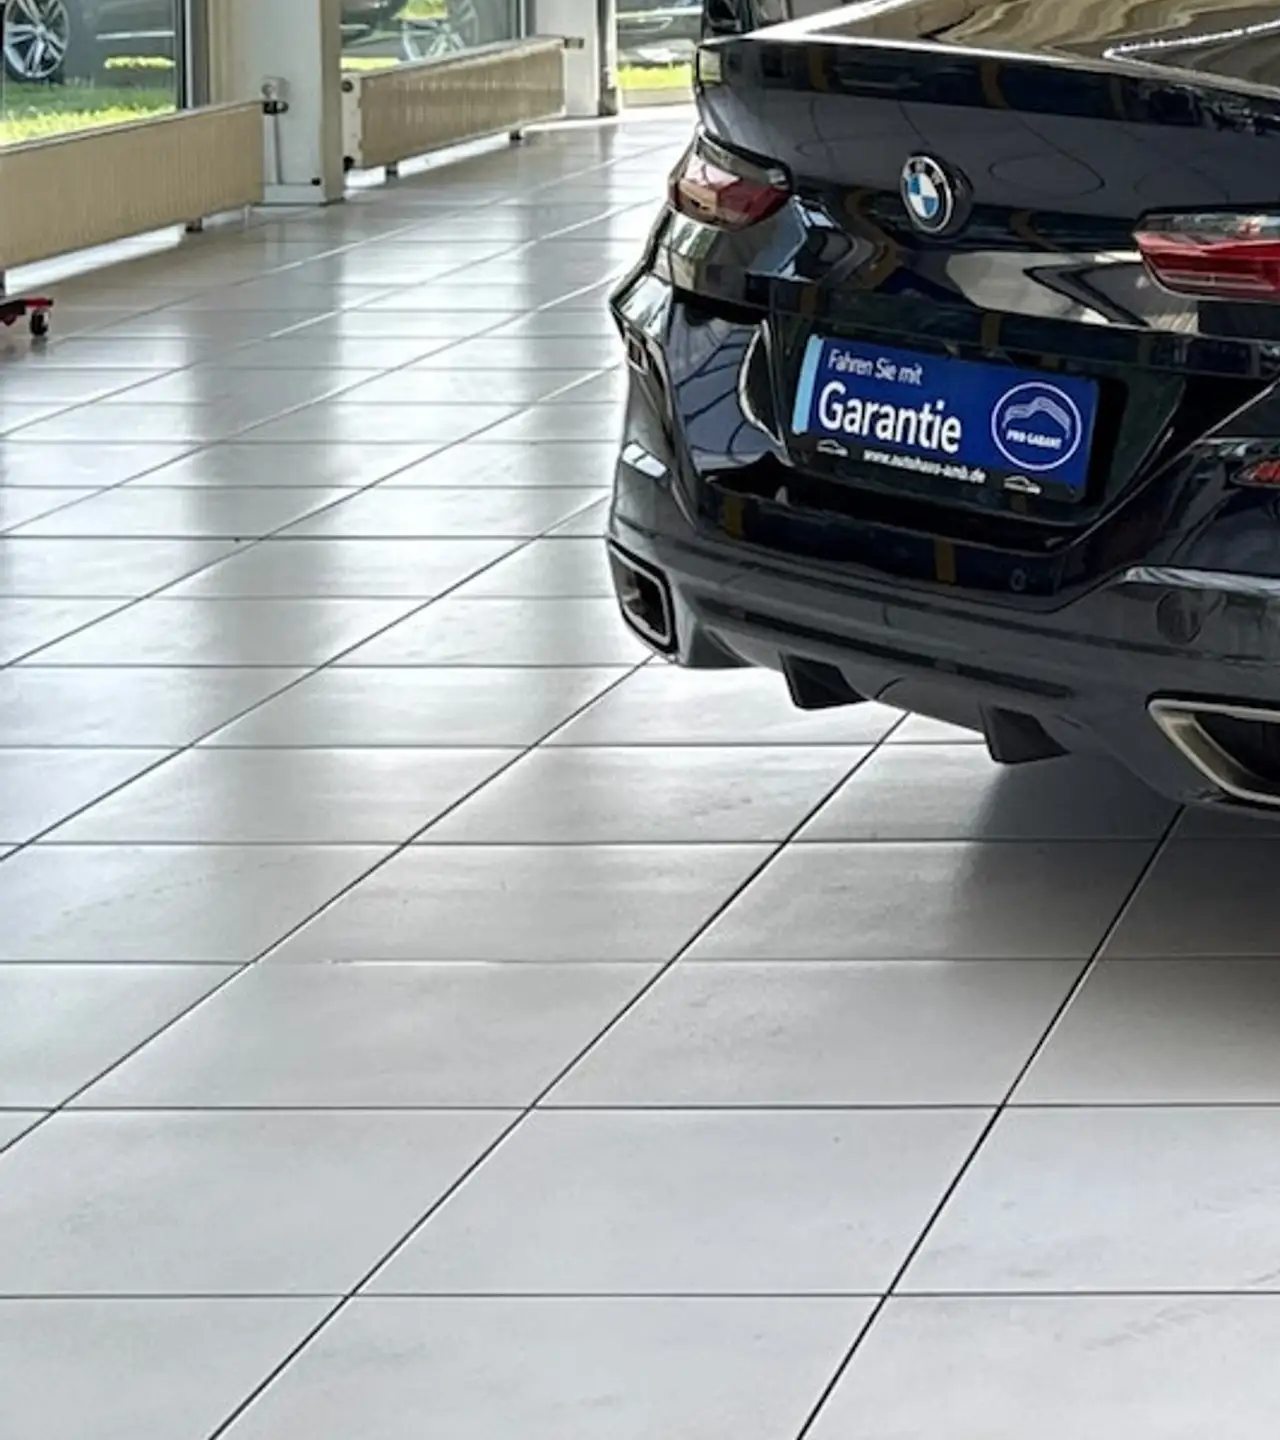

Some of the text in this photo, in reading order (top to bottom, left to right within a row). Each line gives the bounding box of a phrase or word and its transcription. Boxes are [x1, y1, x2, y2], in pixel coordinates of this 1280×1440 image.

[827, 348, 924, 385] Fahren Sie mit
[818, 379, 963, 454] Garantie
